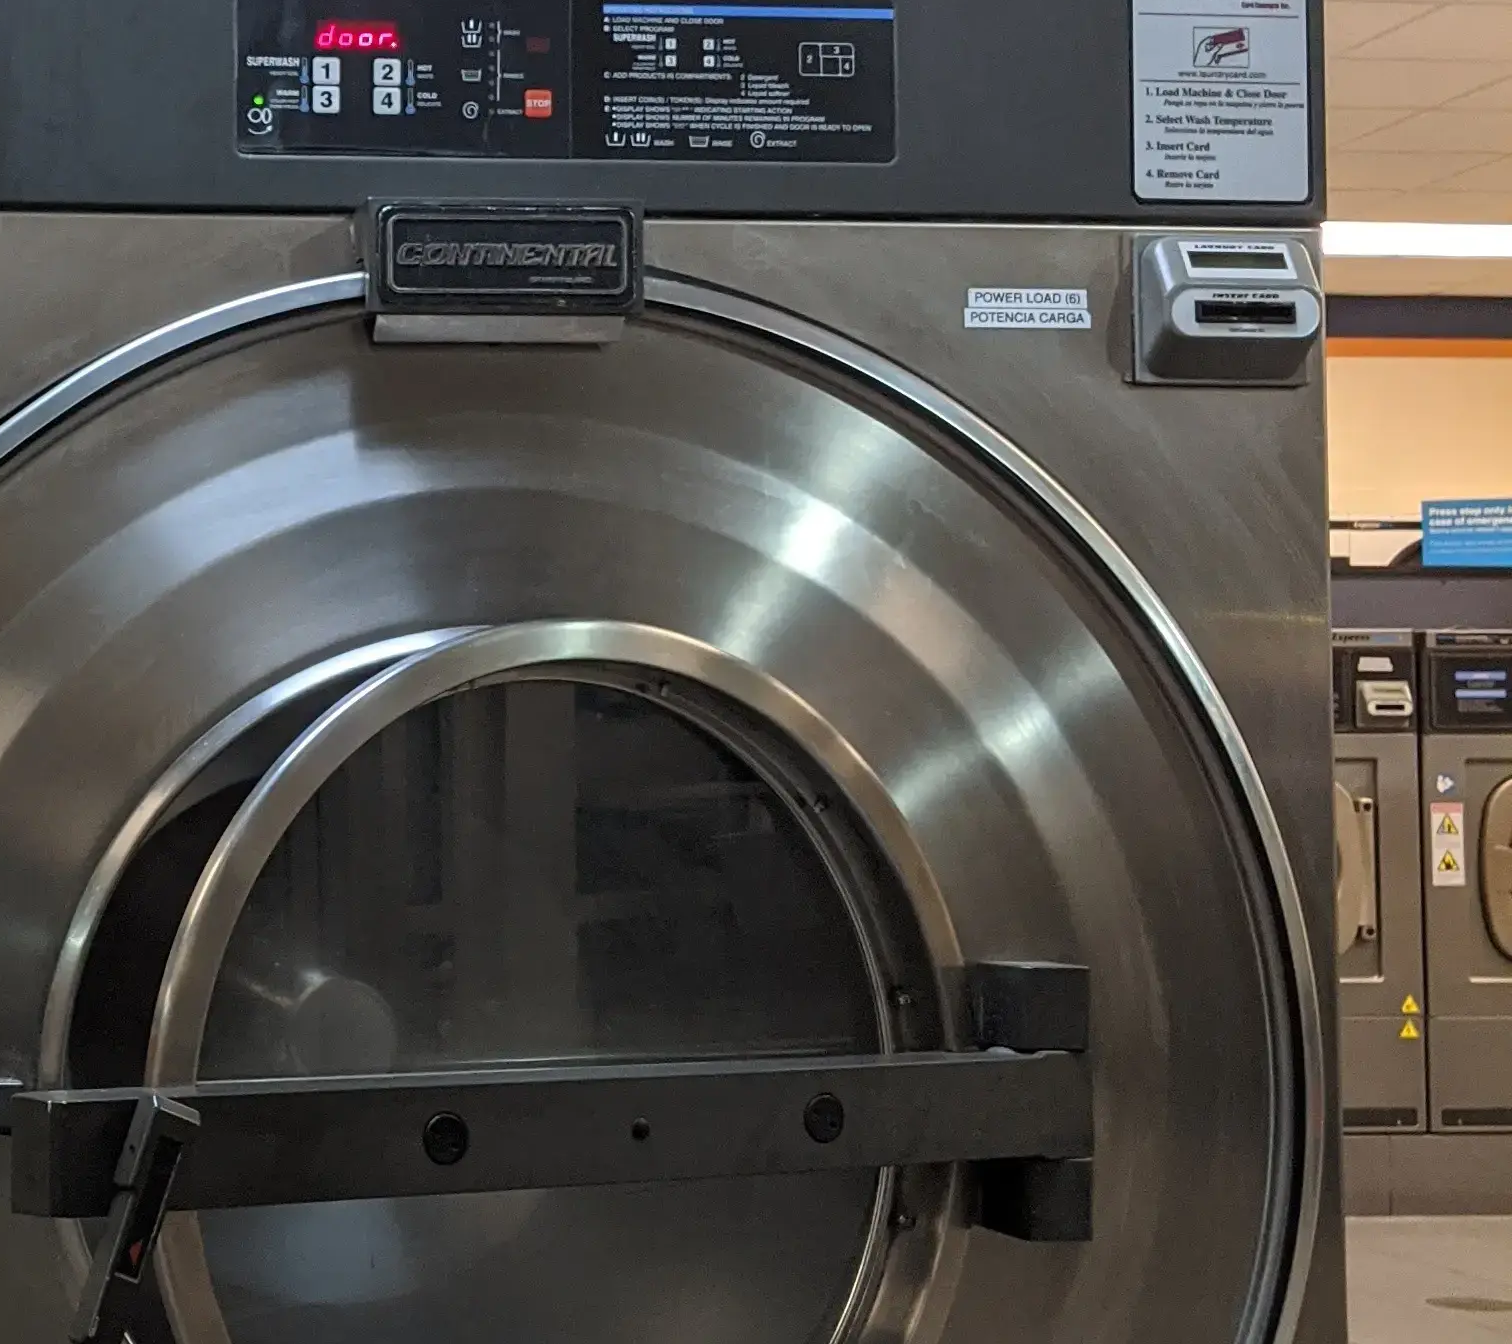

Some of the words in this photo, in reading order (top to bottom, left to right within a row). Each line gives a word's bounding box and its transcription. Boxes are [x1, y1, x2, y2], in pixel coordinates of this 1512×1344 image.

[833, 46, 840, 54] 3
[246, 56, 300, 67] SUPERWASH
[806, 55, 812, 63] 2
[844, 62, 850, 70] 4
[1146, 88, 1153, 96] 1.
[1156, 87, 1179, 97] Load
[1182, 88, 1222, 97] Machine
[1225, 89, 1233, 98] &
[1236, 89, 1260, 98] Close
[1264, 90, 1287, 99] Door
[1145, 114, 1153, 124] 2.
[1156, 115, 1182, 124] Select
[1185, 115, 1210, 125] Wash
[1214, 116, 1272, 127] Temperature
[1146, 141, 1153, 150] 3.
[1156, 142, 1184, 151] Insert
[1186, 142, 1210, 151] Card
[1146, 170, 1153, 178] 4.
[1157, 170, 1193, 179] Remove
[1196, 170, 1220, 179] Card
[396, 242, 618, 267] CONTINENTAL
[974, 292, 1024, 304] POWER
[1027, 293, 1062, 304] LOAD
[1064, 292, 1081, 305] (6)
[970, 311, 1036, 323] POTENCIA
[1039, 312, 1084, 324] CARGA
[1428, 507, 1457, 516] Press
[1428, 518, 1453, 526] case
